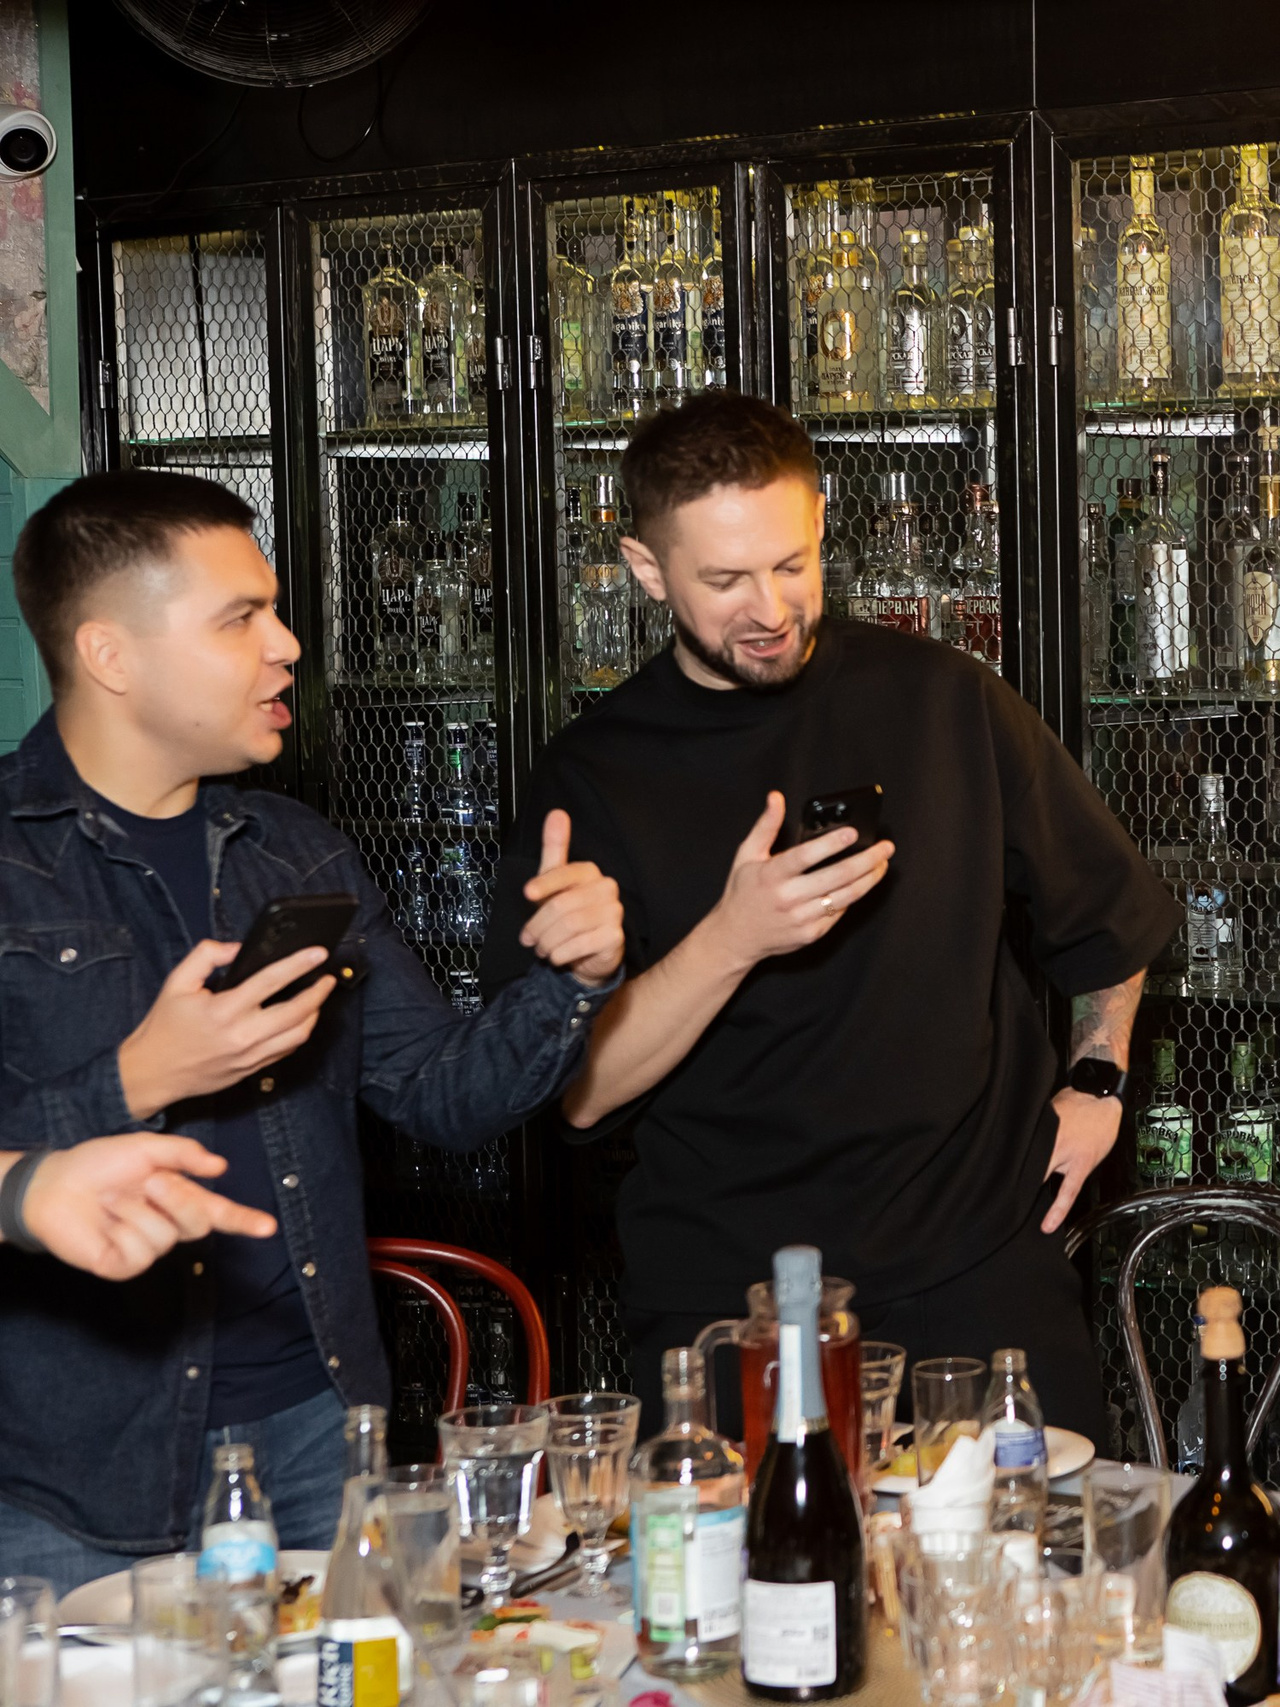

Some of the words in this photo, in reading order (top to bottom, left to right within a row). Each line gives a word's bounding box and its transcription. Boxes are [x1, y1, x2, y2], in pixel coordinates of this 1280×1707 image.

[372, 335, 403, 355] ЦАРЬ
[424, 333, 448, 353] ЦАРЬ
[382, 588, 411, 606] ЦАРЬ
